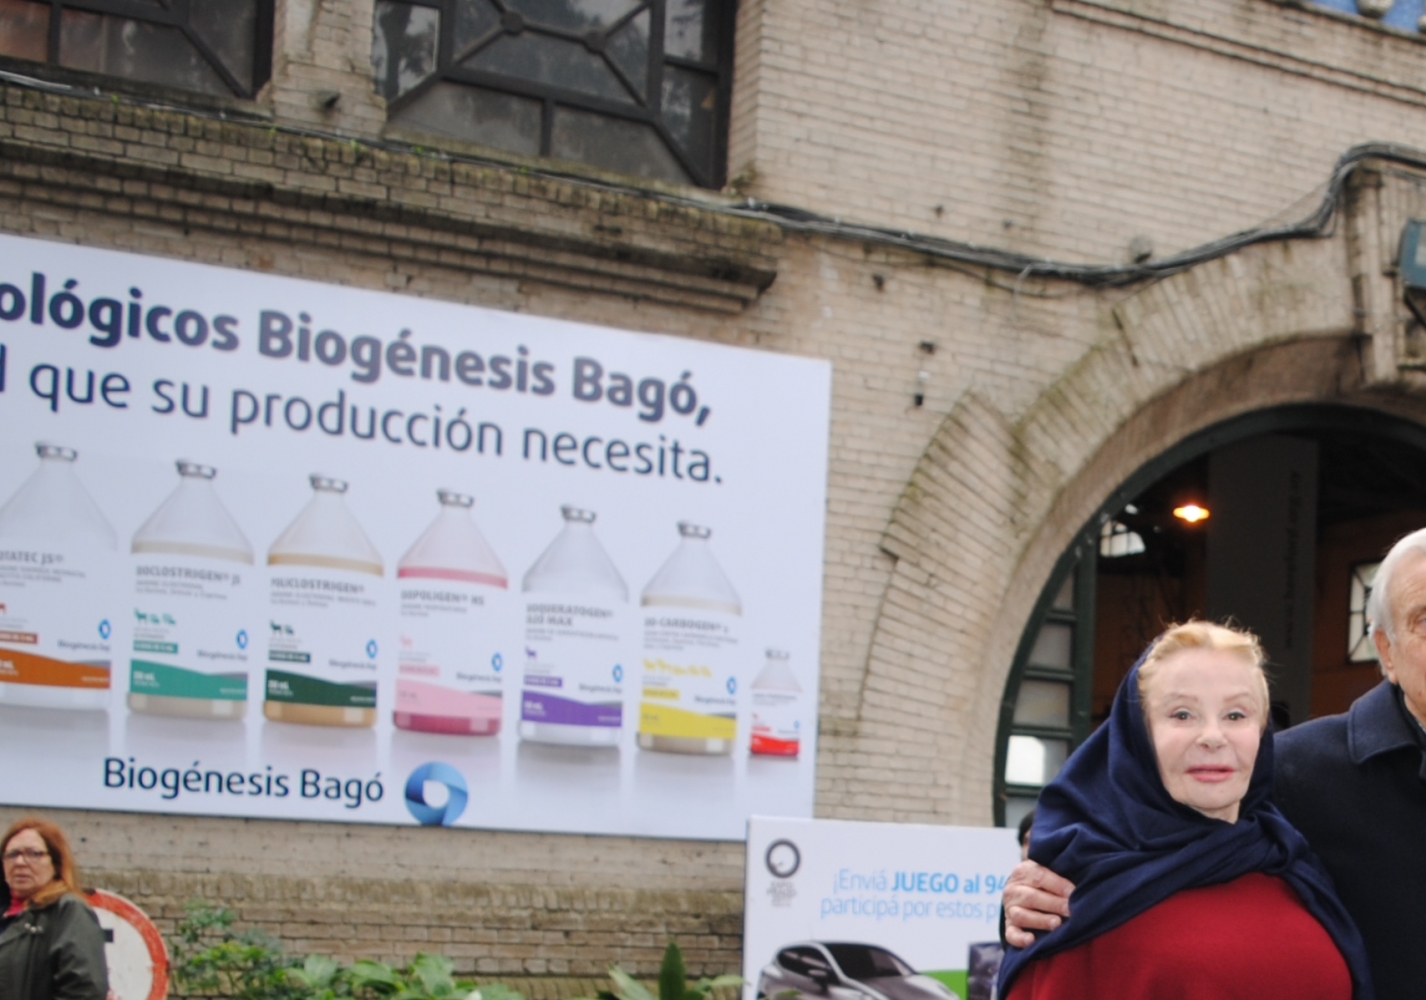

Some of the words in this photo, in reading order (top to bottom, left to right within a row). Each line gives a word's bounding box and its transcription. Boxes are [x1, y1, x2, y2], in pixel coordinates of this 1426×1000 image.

[0, 271, 240, 351] ológicos
[257, 310, 556, 396] Biogénesis
[571, 357, 712, 428] Bagó,
[29, 362, 131, 414] que
[152, 382, 211, 418] su
[230, 388, 503, 457] producción
[522, 428, 723, 485] necesita.
[104, 757, 289, 800] Biogénesis
[300, 769, 384, 809] Bagó
[820, 895, 899, 920] participá
[903, 901, 932, 921] por
[936, 902, 982, 919] estos
[891, 872, 959, 893] JUEGO
[963, 874, 980, 894] al
